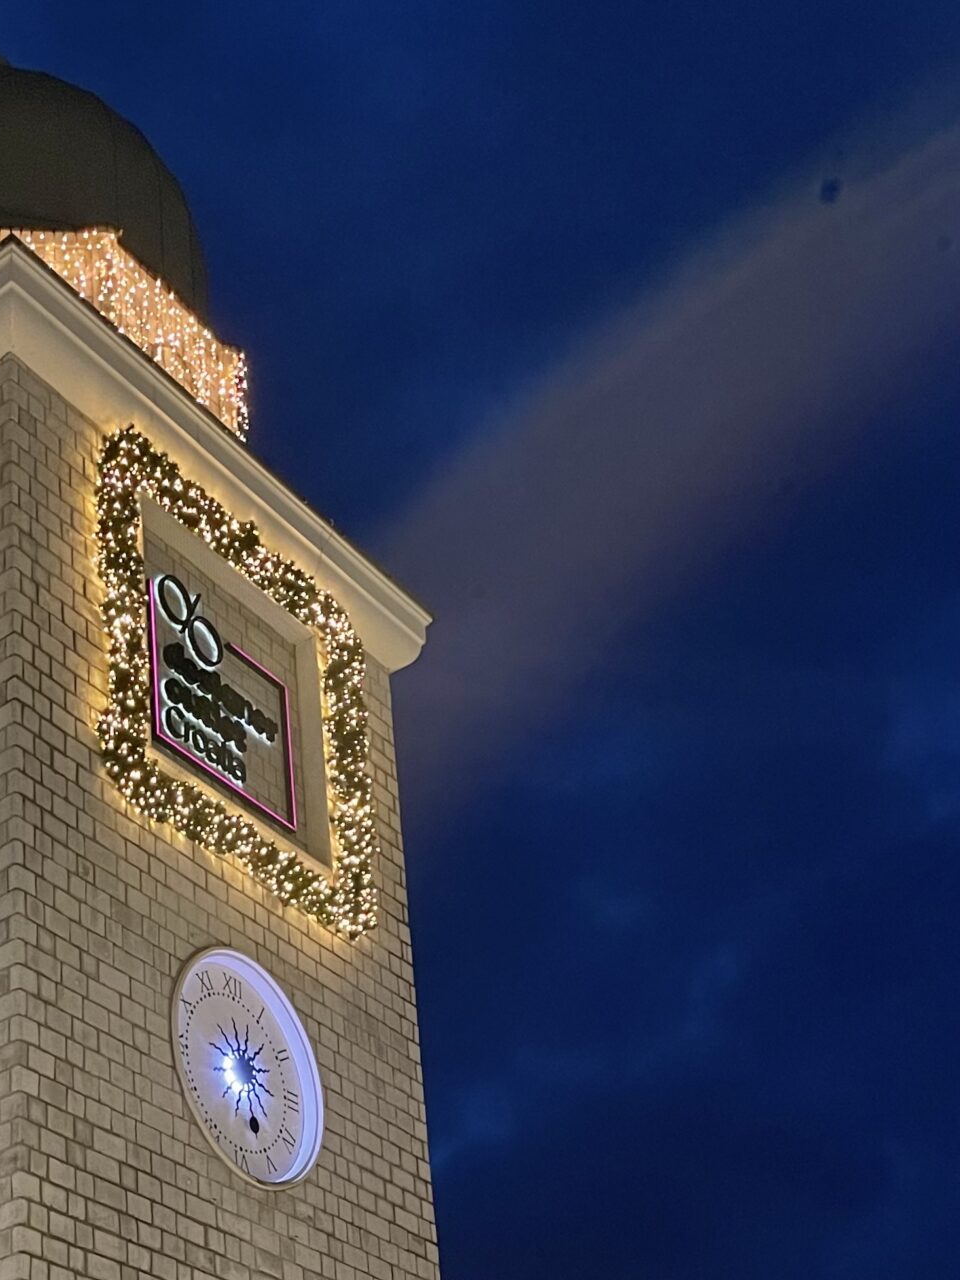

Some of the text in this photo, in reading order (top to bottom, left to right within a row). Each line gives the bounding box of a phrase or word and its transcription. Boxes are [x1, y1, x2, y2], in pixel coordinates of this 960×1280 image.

[164, 706, 247, 784] Croatia
[195, 970, 214, 993] XI
[222, 972, 242, 1000] XII
[257, 1007, 265, 1019] I
[277, 1048, 290, 1062] II
[286, 1089, 299, 1113] III
[281, 1127, 296, 1154] IV
[266, 1154, 278, 1175] V
